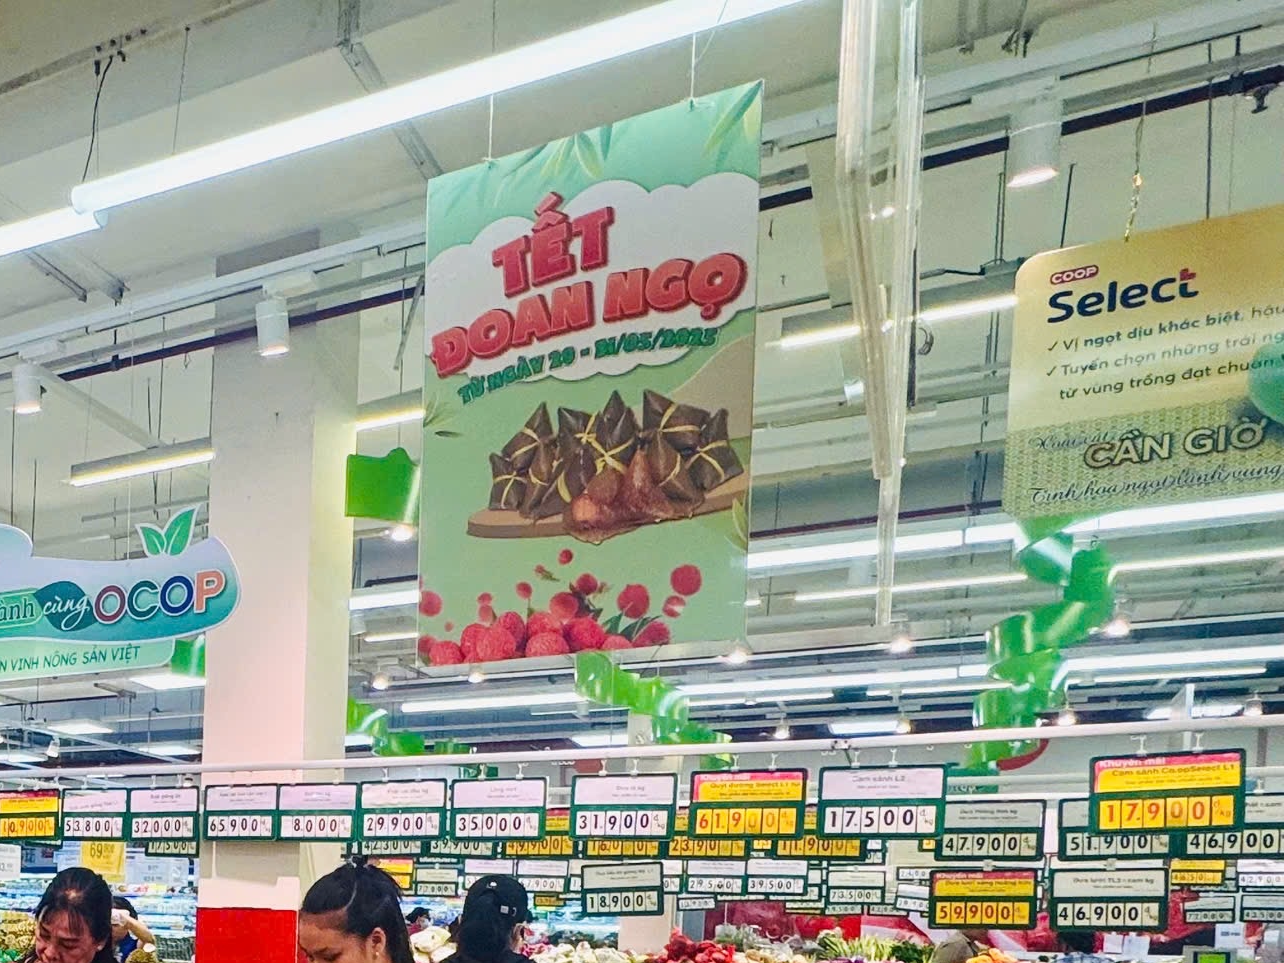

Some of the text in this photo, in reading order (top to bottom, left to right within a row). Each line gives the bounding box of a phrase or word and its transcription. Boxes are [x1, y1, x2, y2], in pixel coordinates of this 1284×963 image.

[492, 191, 614, 298] TẾT
[430, 253, 748, 378] ĐOAN NGỌ
[1047, 268, 1199, 324] Select
[1062, 338, 1079, 352] Vị
[1084, 332, 1122, 348] ngọt
[1127, 325, 1153, 341] dịu
[1158, 318, 1201, 335] khác
[1114, 352, 1156, 370] chọn
[1161, 341, 1220, 360] những
[1225, 332, 1256, 349] trái
[487, 353, 545, 393] NGÀY
[1059, 384, 1078, 400] từ
[1181, 365, 1211, 382] đạt
[1083, 417, 1266, 469] CẦN GIỜ
[43, 594, 92, 632] cùng
[93, 569, 227, 625] OCOP
[10, 656, 39, 673] VINH
[43, 650, 77, 669] NÔNG
[82, 645, 109, 665] SẢN
[111, 643, 141, 663] VIỆT
[830, 809, 914, 828] 17.500
